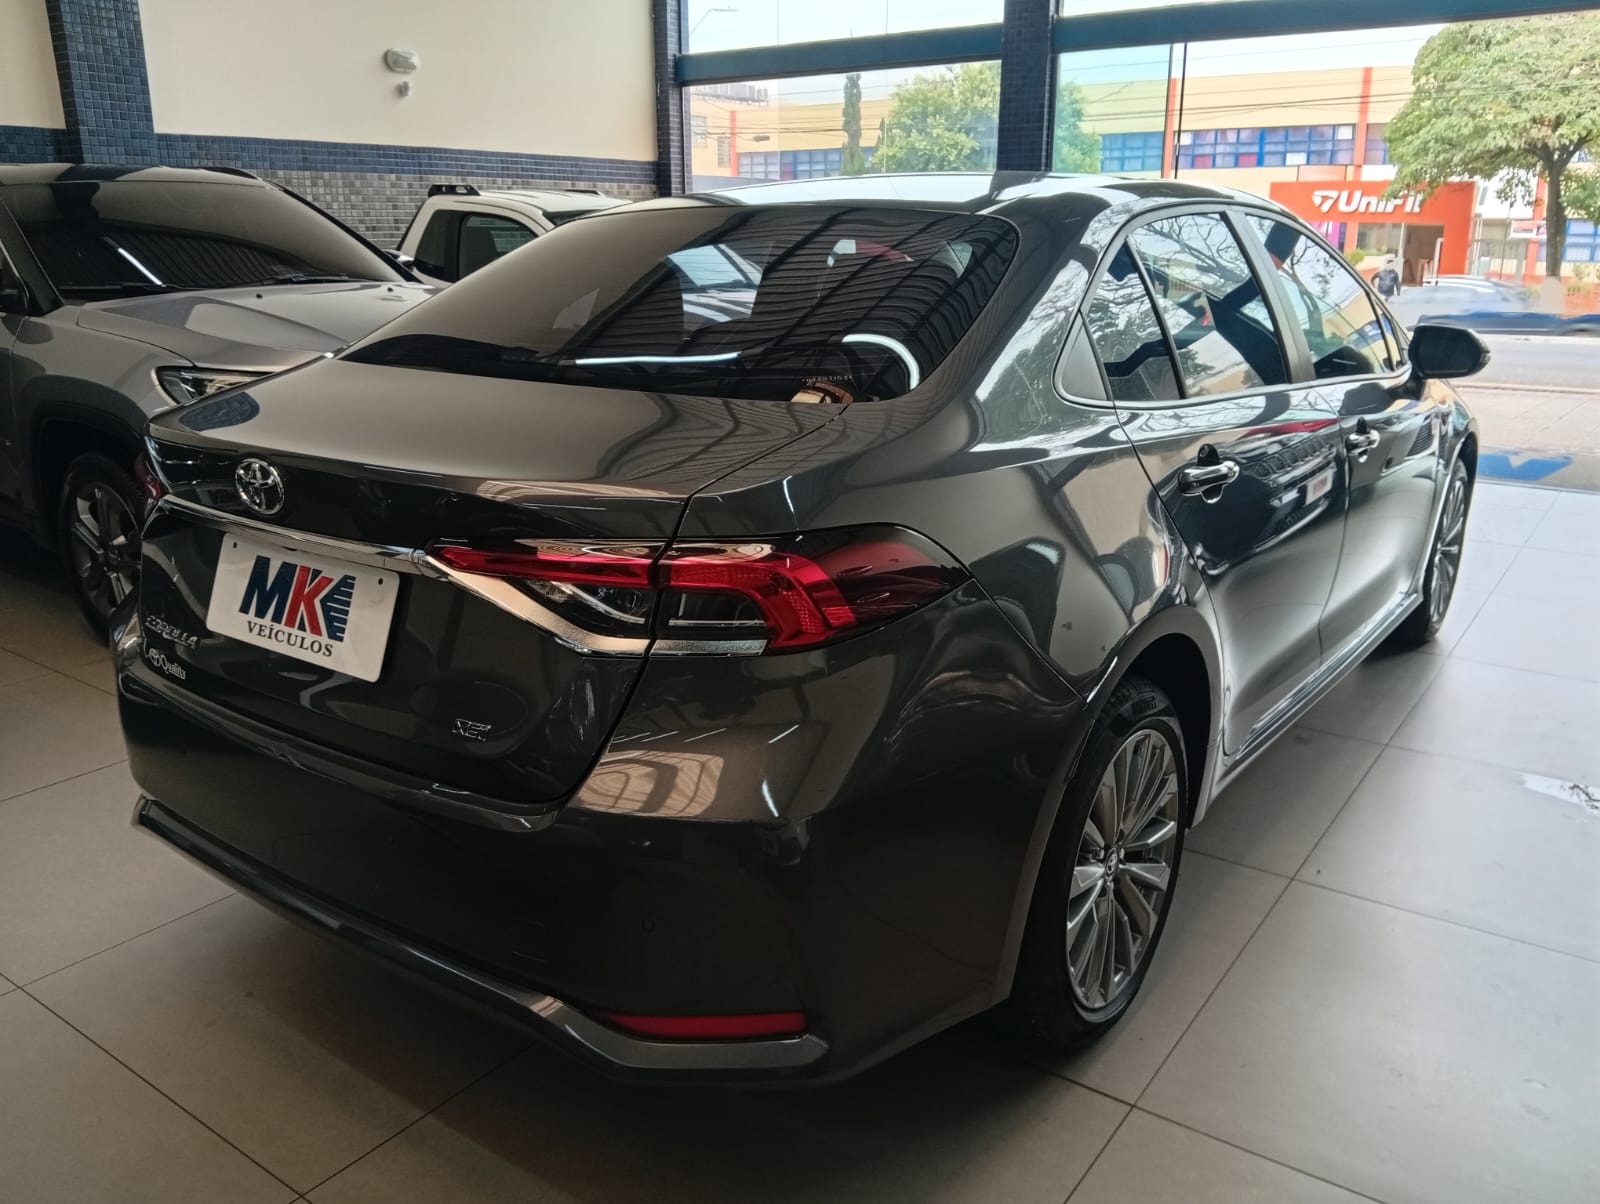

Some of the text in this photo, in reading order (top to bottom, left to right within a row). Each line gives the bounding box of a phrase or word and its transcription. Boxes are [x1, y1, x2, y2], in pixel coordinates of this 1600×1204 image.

[238, 554, 335, 638] MK
[246, 619, 334, 658] VEÍCULOS
[160, 654, 187, 681] Quality
